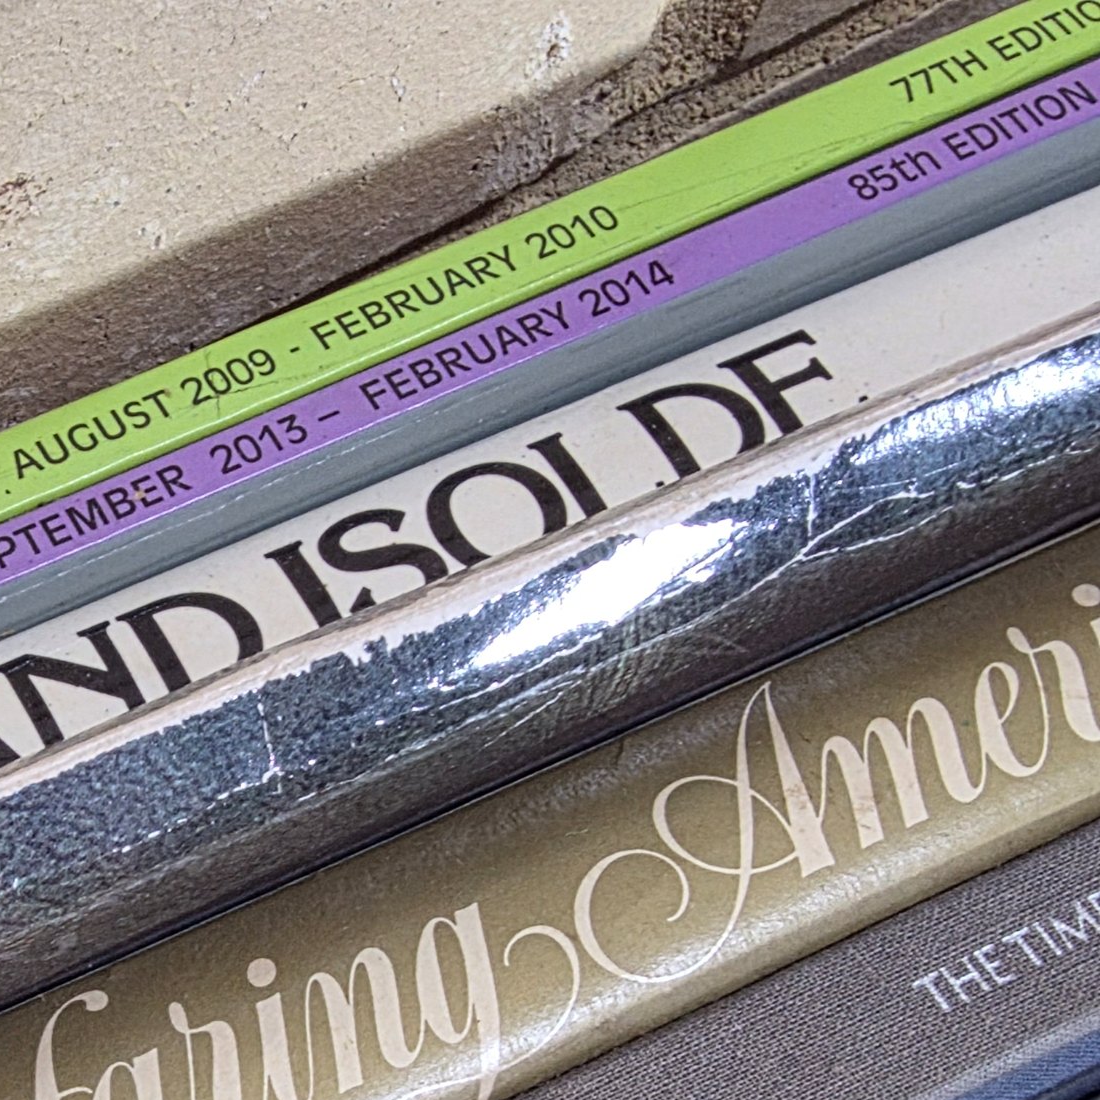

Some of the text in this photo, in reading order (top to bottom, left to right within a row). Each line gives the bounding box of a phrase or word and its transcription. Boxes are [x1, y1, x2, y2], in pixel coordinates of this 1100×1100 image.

[889, 49, 988, 102] 77TH
[849, 81, 1098, 200] 85th EDITION
[11, 391, 171, 480] AUGUST
[180, 348, 277, 407] 2009
[309, 244, 520, 351] FEBRUARY
[525, 206, 619, 259] 2010
[209, 413, 308, 475] 2013
[359, 301, 572, 410] FEBRUARY
[578, 260, 675, 318] 2014
[912, 944, 1018, 1013] THE
